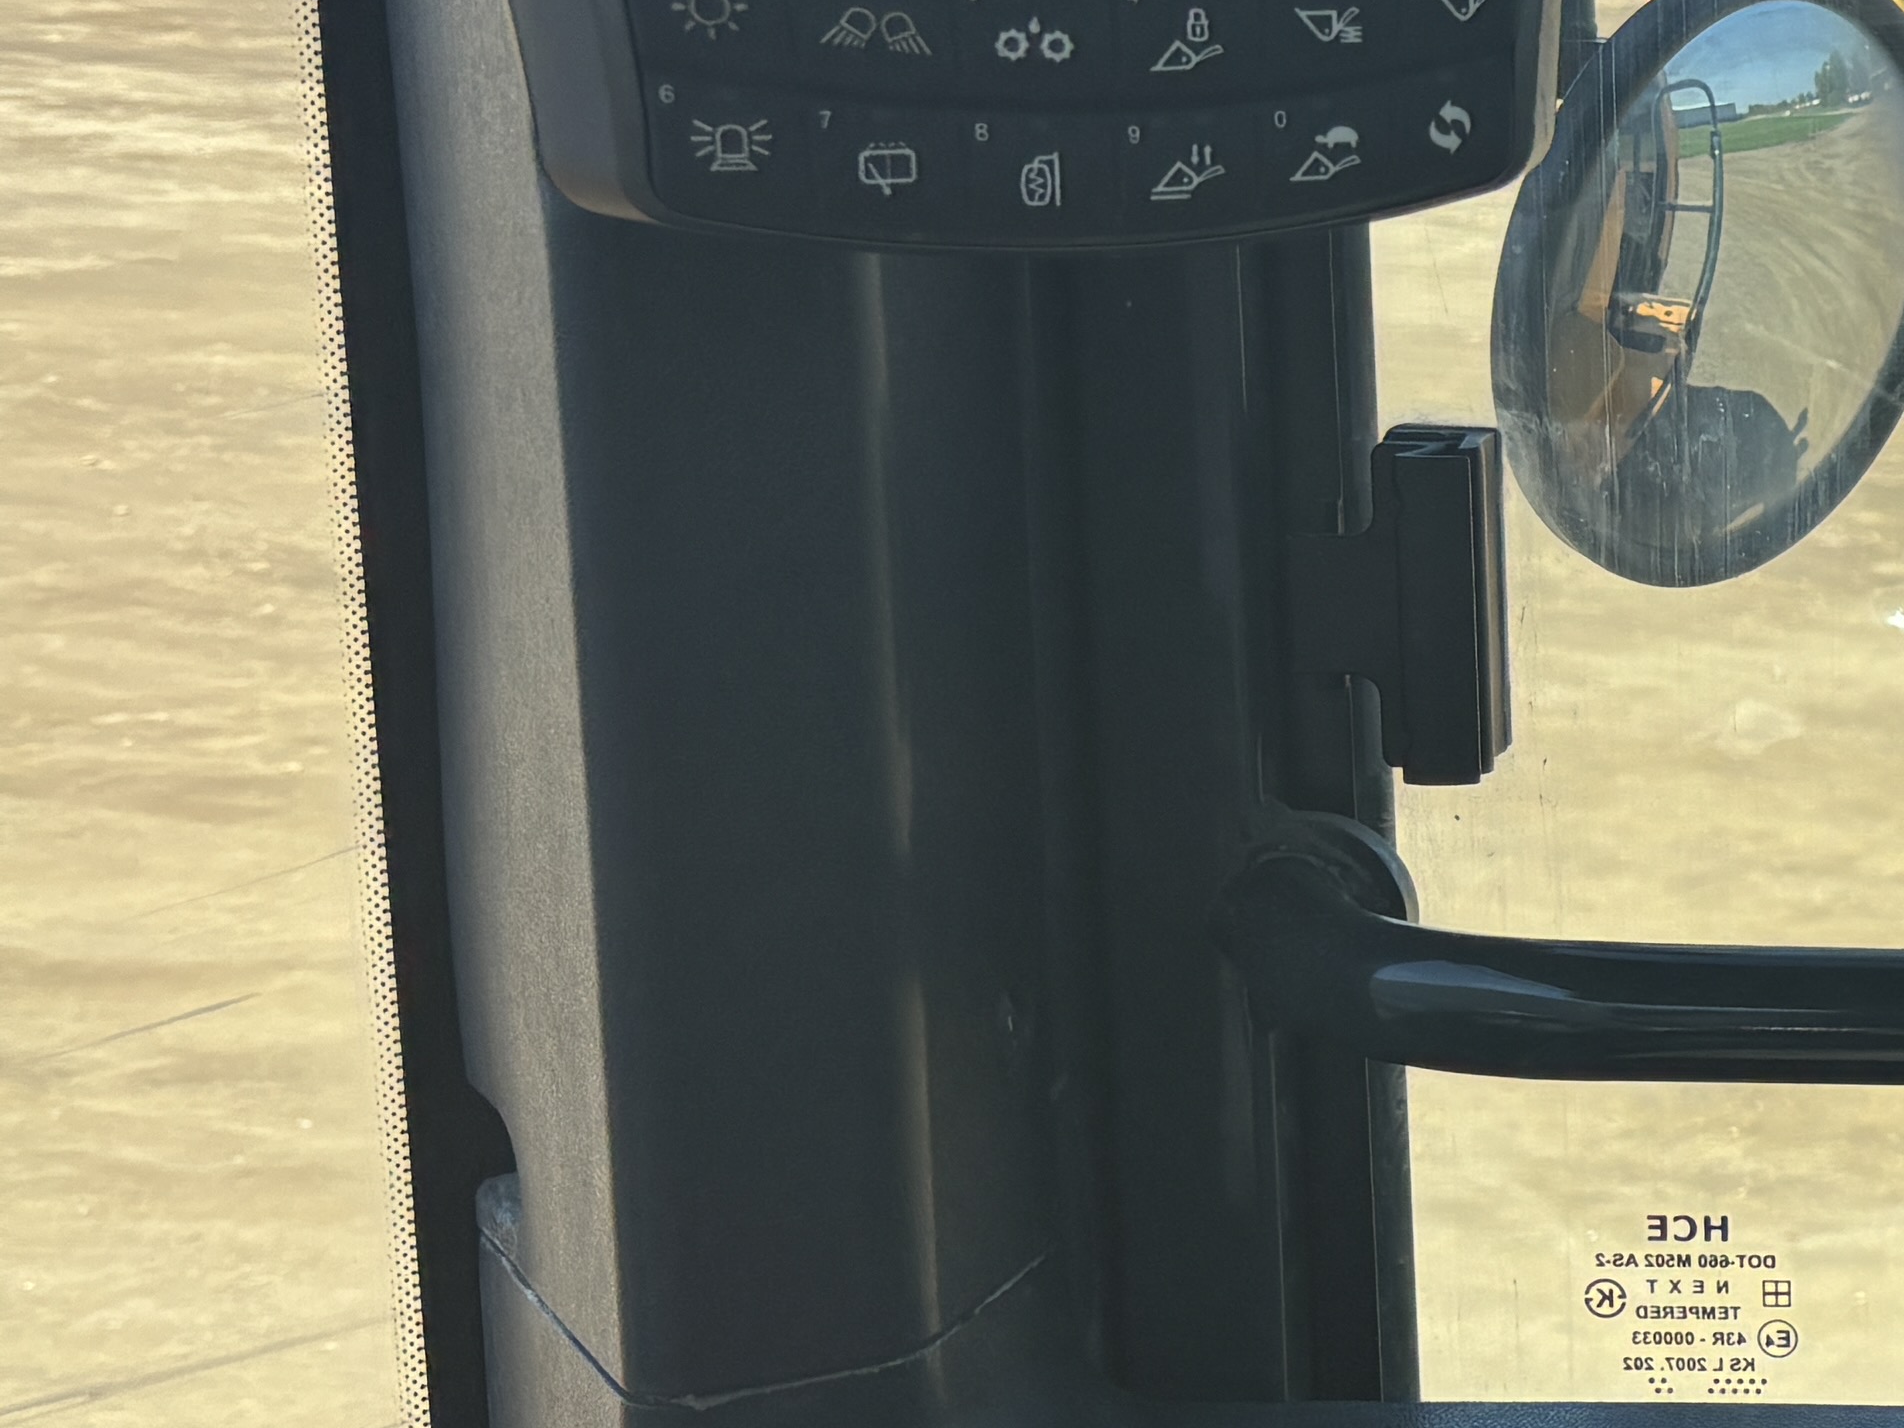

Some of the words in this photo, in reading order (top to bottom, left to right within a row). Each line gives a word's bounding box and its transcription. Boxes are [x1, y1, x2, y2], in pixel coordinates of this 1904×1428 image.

[659, 84, 674, 103] 6
[819, 110, 831, 129] 7
[1274, 110, 1287, 129] 0
[975, 122, 989, 142] 8
[1128, 125, 1140, 145] 9
